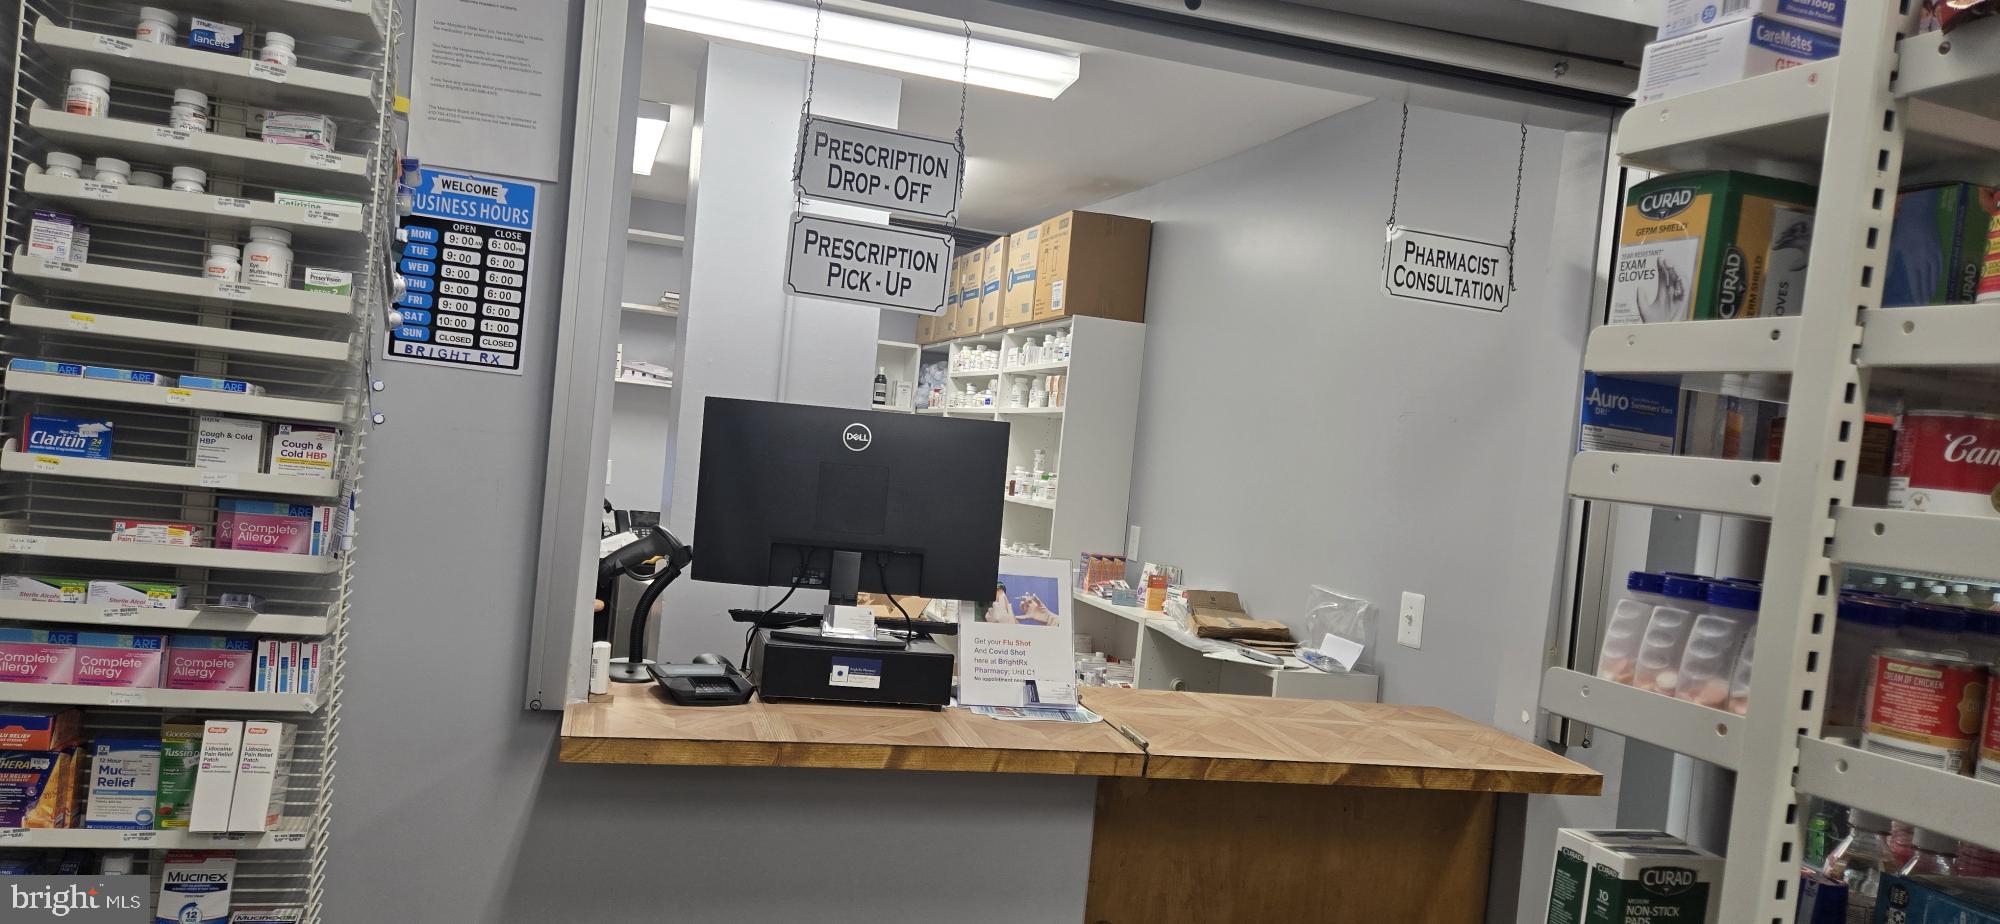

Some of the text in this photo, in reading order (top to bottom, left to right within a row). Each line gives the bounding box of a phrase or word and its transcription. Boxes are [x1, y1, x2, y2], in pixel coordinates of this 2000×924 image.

[194, 34, 230, 48] lancets
[1756, 25, 1812, 52] CareMates
[814, 132, 949, 178] PRESCRIPTION
[442, 179, 498, 197] WELCOME
[1641, 190, 1691, 212] CURAD
[413, 193, 529, 225] USINESS HOURS
[411, 229, 431, 239] MON
[453, 224, 522, 240] OPEN CLOSE
[1636, 223, 1688, 237] GERM SHIELD
[412, 246, 428, 256] TUE
[804, 229, 938, 273] PRESCRIPTION
[1404, 240, 1499, 276] PHARMACIST
[408, 262, 429, 272] WED
[1620, 259, 1646, 271] EXAM
[1618, 270, 1656, 283] GLOVES
[408, 279, 426, 289] THU
[1394, 265, 1504, 303] CONSULTATION
[1720, 254, 1740, 319] CURAD
[408, 295, 423, 305] FRI
[404, 312, 423, 322] SAT
[403, 328, 514, 348] SUN CLOSED CLOSED
[404, 344, 501, 365] BRIGHT RX
[1586, 388, 1629, 411] Auro
[30, 431, 86, 448] Claritin
[200, 430, 224, 439] Cough
[847, 432, 868, 442] DELL
[282, 440, 314, 450] Cough
[280, 450, 328, 461] Cold HBP
[239, 522, 298, 535] Complete
[238, 532, 279, 544] Allergy
[0, 662, 37, 675] llergy
[80, 656, 143, 668] Complete
[175, 657, 235, 668] Complete
[998, 658, 1028, 666] BrightRx
[79, 666, 122, 679] Allergy
[173, 666, 216, 679] Allergy
[1883, 672, 1904, 683] CREAM
[1914, 677, 1944, 689] CHICKEN
[165, 748, 193, 757] Tussin
[0, 760, 38, 769] HERA
[98, 778, 136, 787] Relief
[1563, 848, 1582, 861] CURAD
[1597, 865, 1619, 879] CURAD
[1643, 870, 1692, 886] CURAD
[1600, 889, 1609, 901] 10
[1626, 905, 1680, 918] NON-STICK
